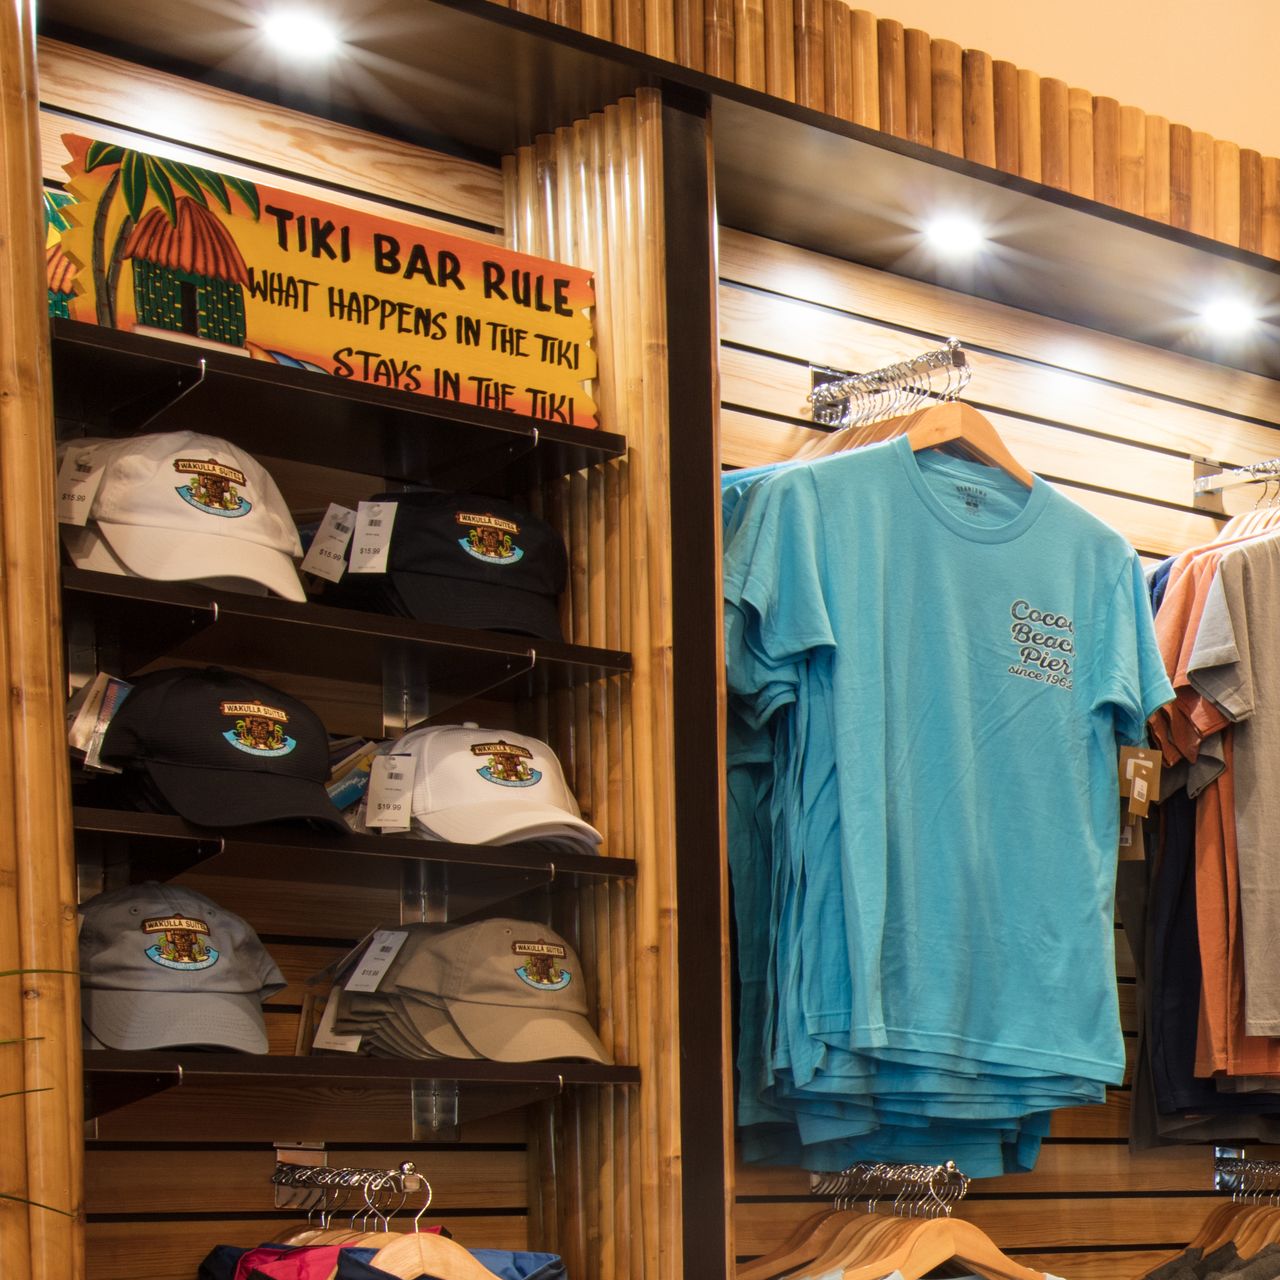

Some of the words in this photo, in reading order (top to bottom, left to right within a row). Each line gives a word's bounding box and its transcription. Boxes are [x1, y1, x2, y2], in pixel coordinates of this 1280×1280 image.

[265, 204, 351, 263] TIKI
[373, 232, 466, 291] BAR
[482, 260, 574, 318] RULE
[248, 266, 320, 312] WHAT
[328, 286, 448, 341] HAPPENS
[456, 314, 482, 347] IN
[486, 321, 529, 358] THE
[534, 333, 580, 371] TIKI
[333, 347, 422, 393] STAYS
[434, 367, 461, 401] IN
[468, 375, 516, 413] THE
[525, 387, 575, 425] TIKI
[179, 461, 217, 474] WAKULLA
[461, 514, 492, 525] WAKULLA
[319, 548, 342, 561] $15.99
[359, 547, 381, 555] $15.99
[1020, 646, 1072, 676] Pier
[1008, 665, 1044, 681] since
[226, 703, 261, 714] WAKULLA
[377, 803, 402, 811] $19.99
[148, 919, 183, 929] WAKULLA
